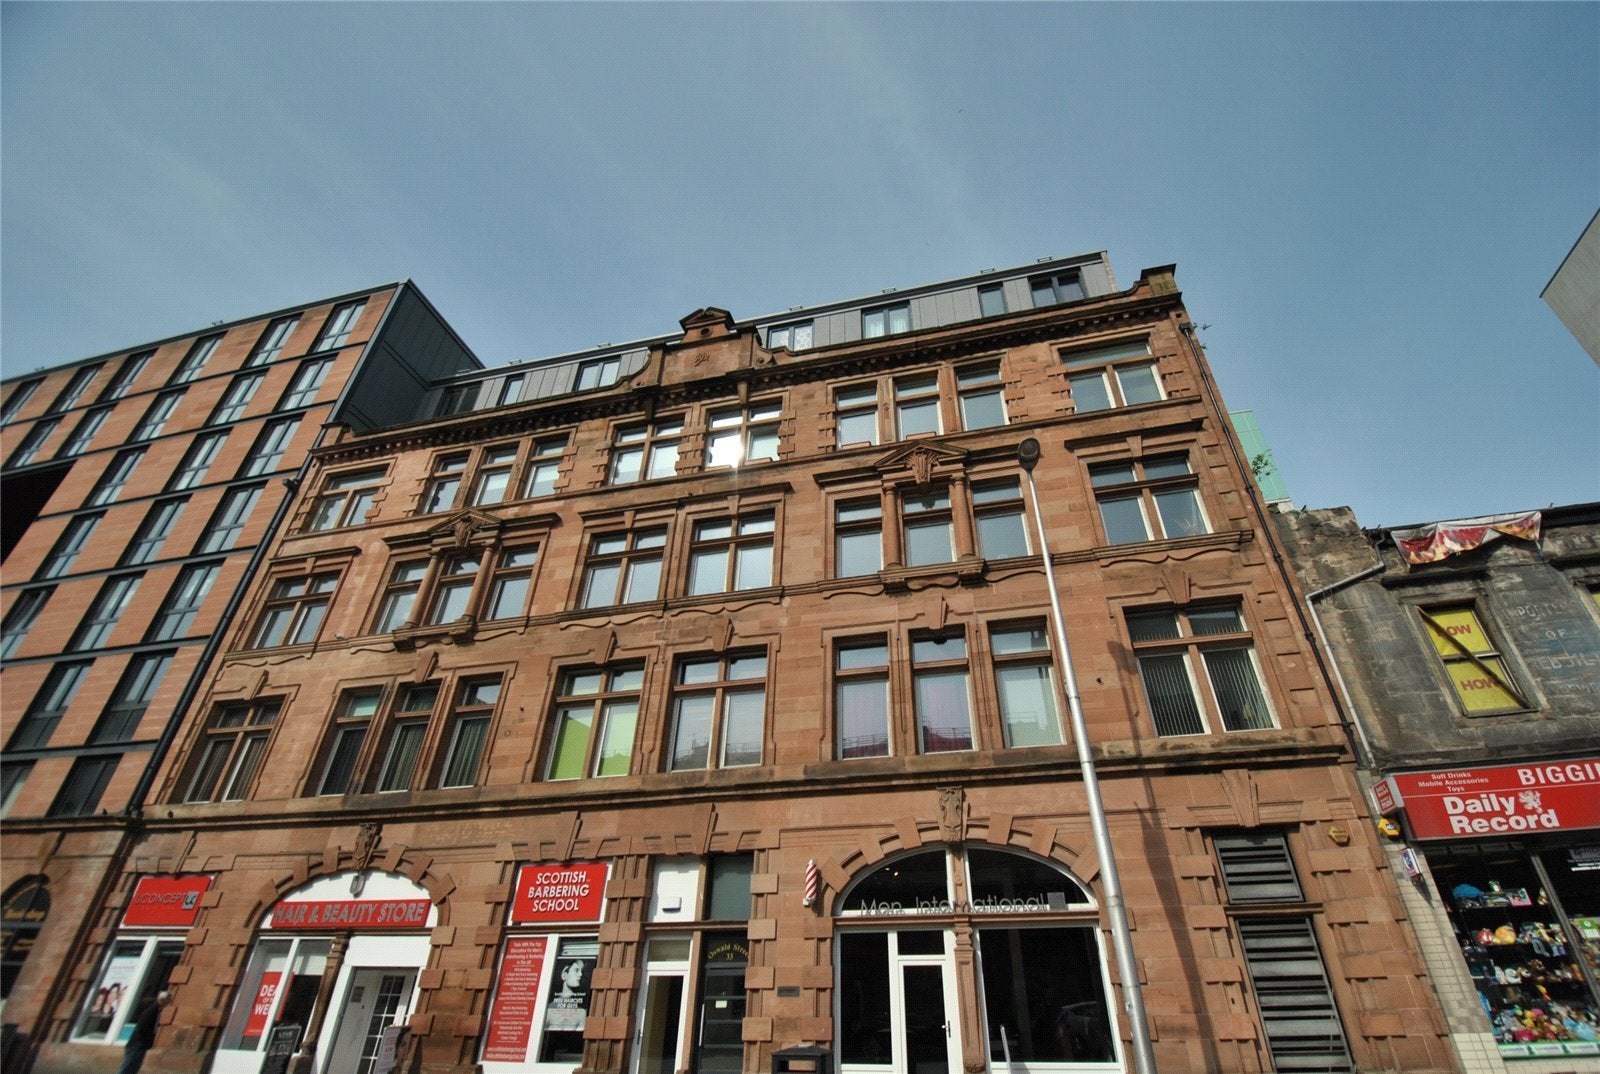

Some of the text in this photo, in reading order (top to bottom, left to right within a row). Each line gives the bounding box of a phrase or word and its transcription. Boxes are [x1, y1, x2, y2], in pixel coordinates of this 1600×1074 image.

[1437, 625, 1472, 637] OW
[1418, 777, 1489, 788] Mobile Accessories
[1442, 794, 1515, 815] Daily
[1449, 809, 1561, 835] Record
[535, 871, 587, 885] SCOTTISH
[528, 884, 590, 898] BARBERING
[532, 898, 579, 912] SCHOOL
[915, 892, 1046, 915] International
[272, 902, 426, 923] HAIR & BEAUTY STORE
[708, 944, 731, 959] Oswald
